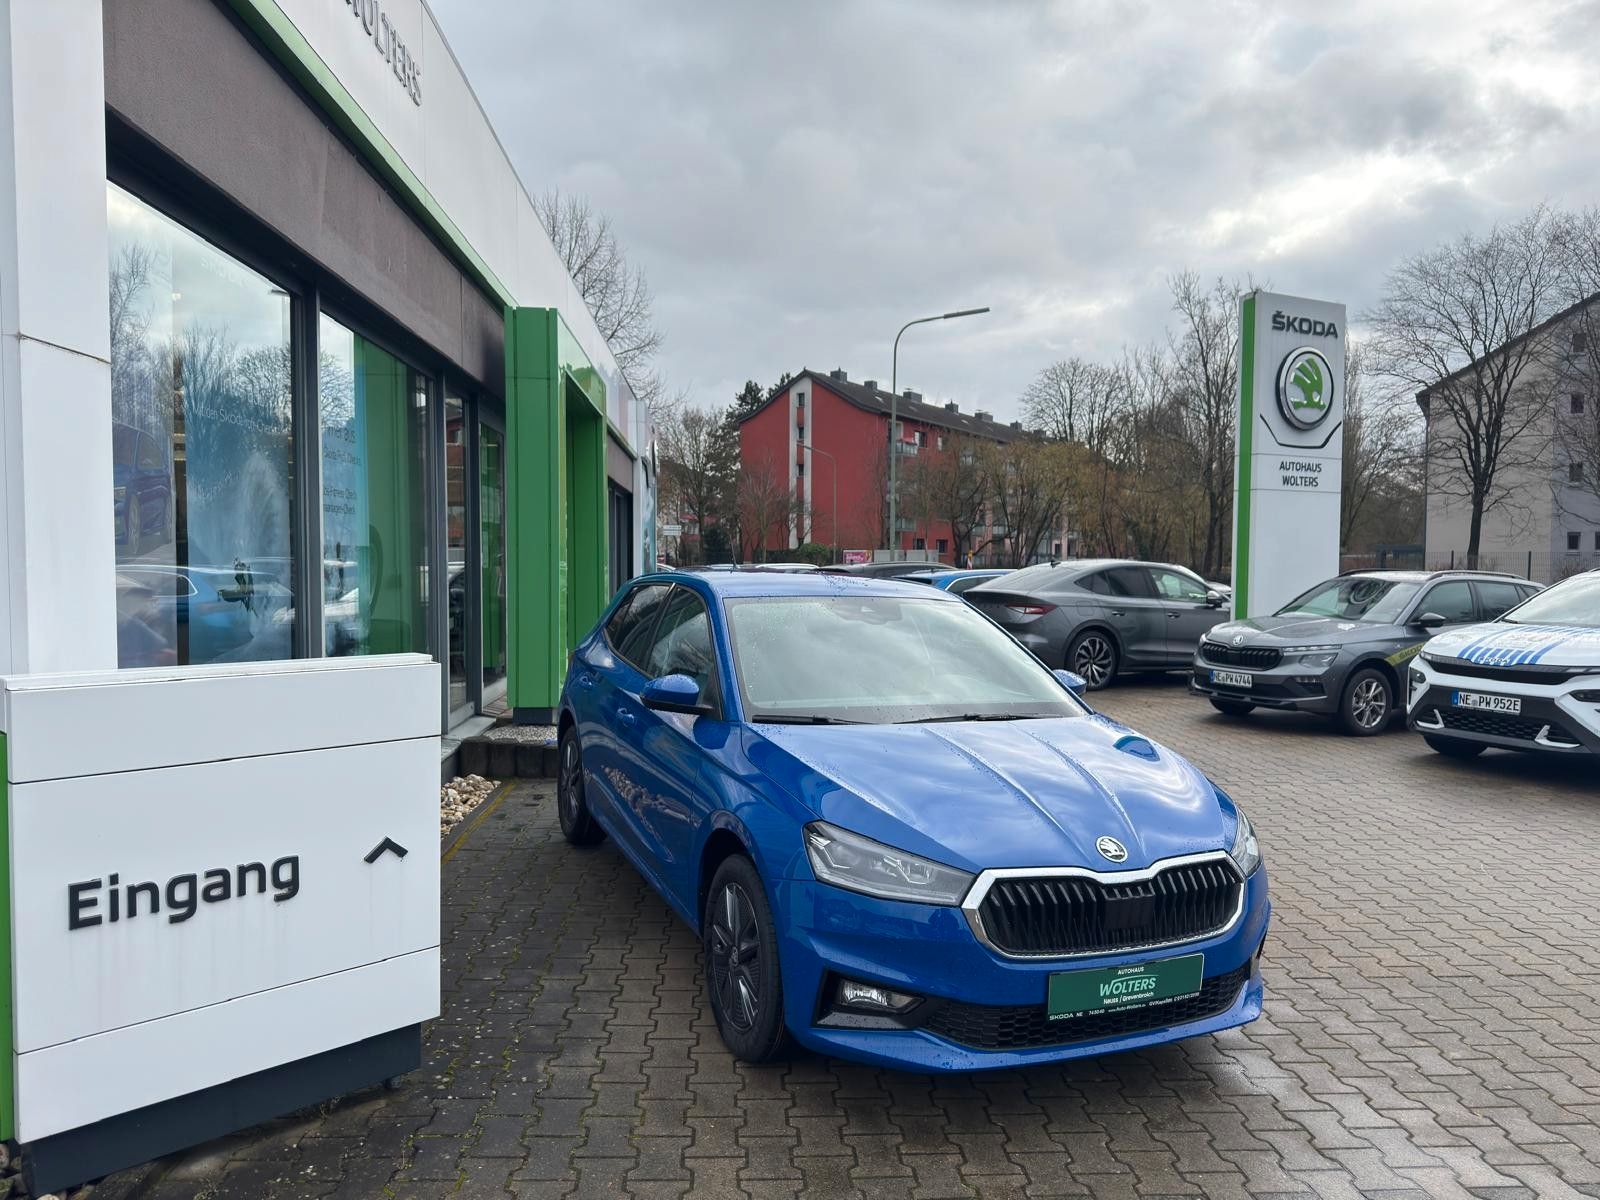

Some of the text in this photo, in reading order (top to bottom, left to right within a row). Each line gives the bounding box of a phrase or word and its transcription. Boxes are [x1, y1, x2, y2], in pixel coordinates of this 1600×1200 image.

[345, 0, 422, 108] OLTERS
[1272, 310, 1339, 340] ŠKODA
[1279, 461, 1322, 473] AUTOHAUS
[1282, 475, 1319, 487] WOLTERS
[1235, 674, 1251, 686] 4744
[1459, 693, 1520, 712] NE PW 952E
[68, 855, 300, 931] Eingang
[1118, 966, 1145, 975] AUTOHAUS
[1100, 976, 1157, 997] WOLTERS
